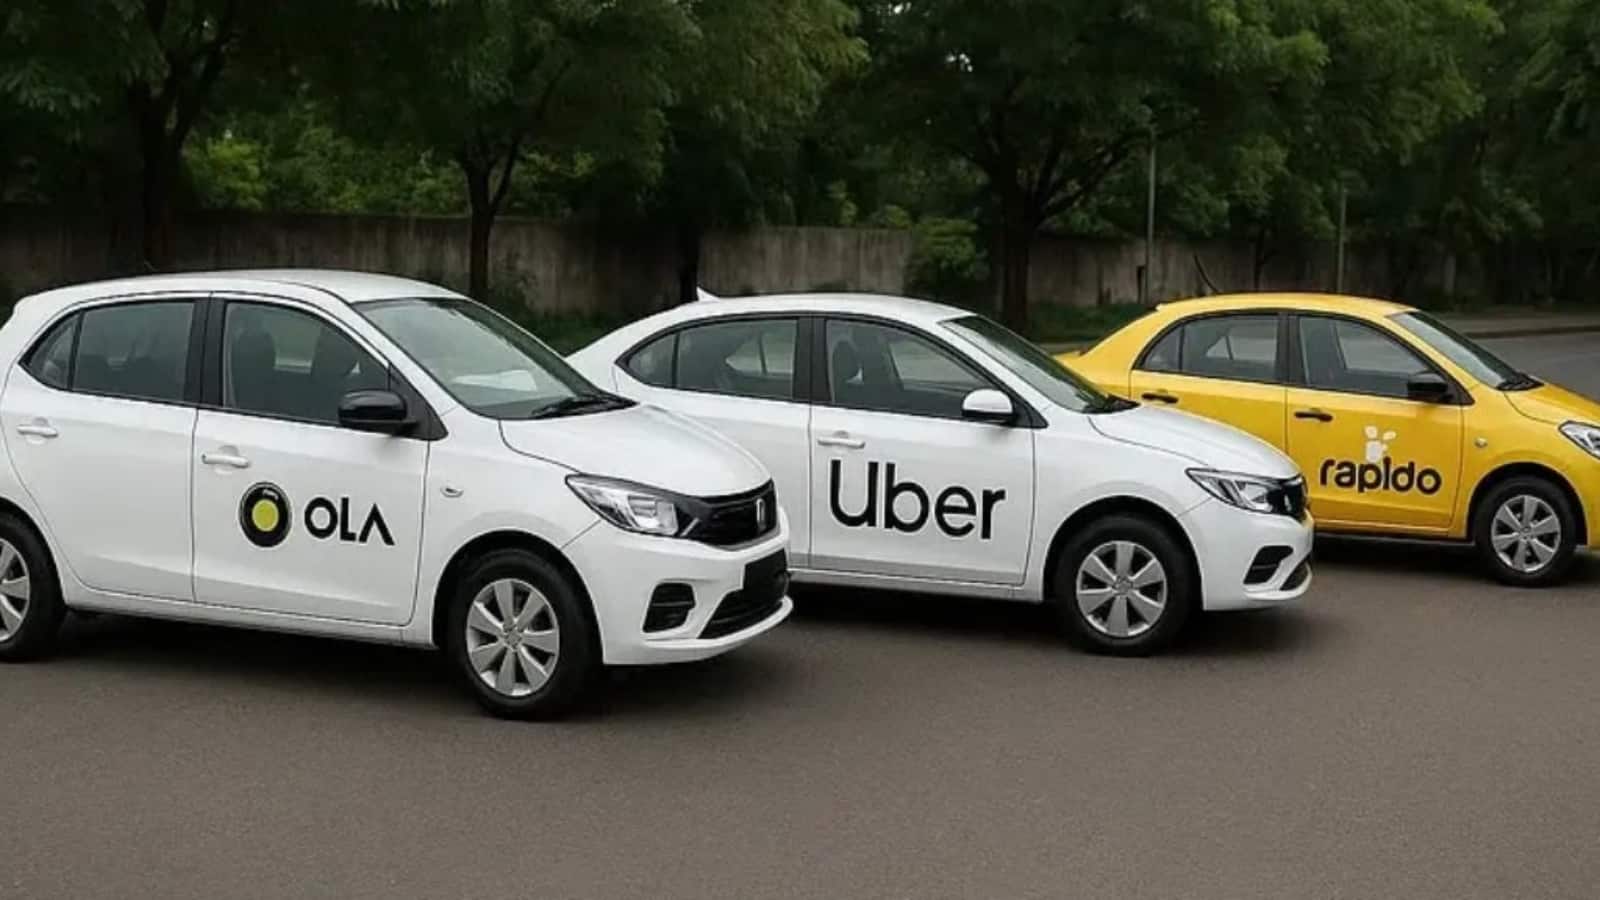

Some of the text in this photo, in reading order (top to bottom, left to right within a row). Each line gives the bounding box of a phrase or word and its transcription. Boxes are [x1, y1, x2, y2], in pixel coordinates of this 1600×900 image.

[830, 459, 1006, 539] Uber
[1320, 456, 1442, 494] rapido
[303, 497, 395, 546] OLA
